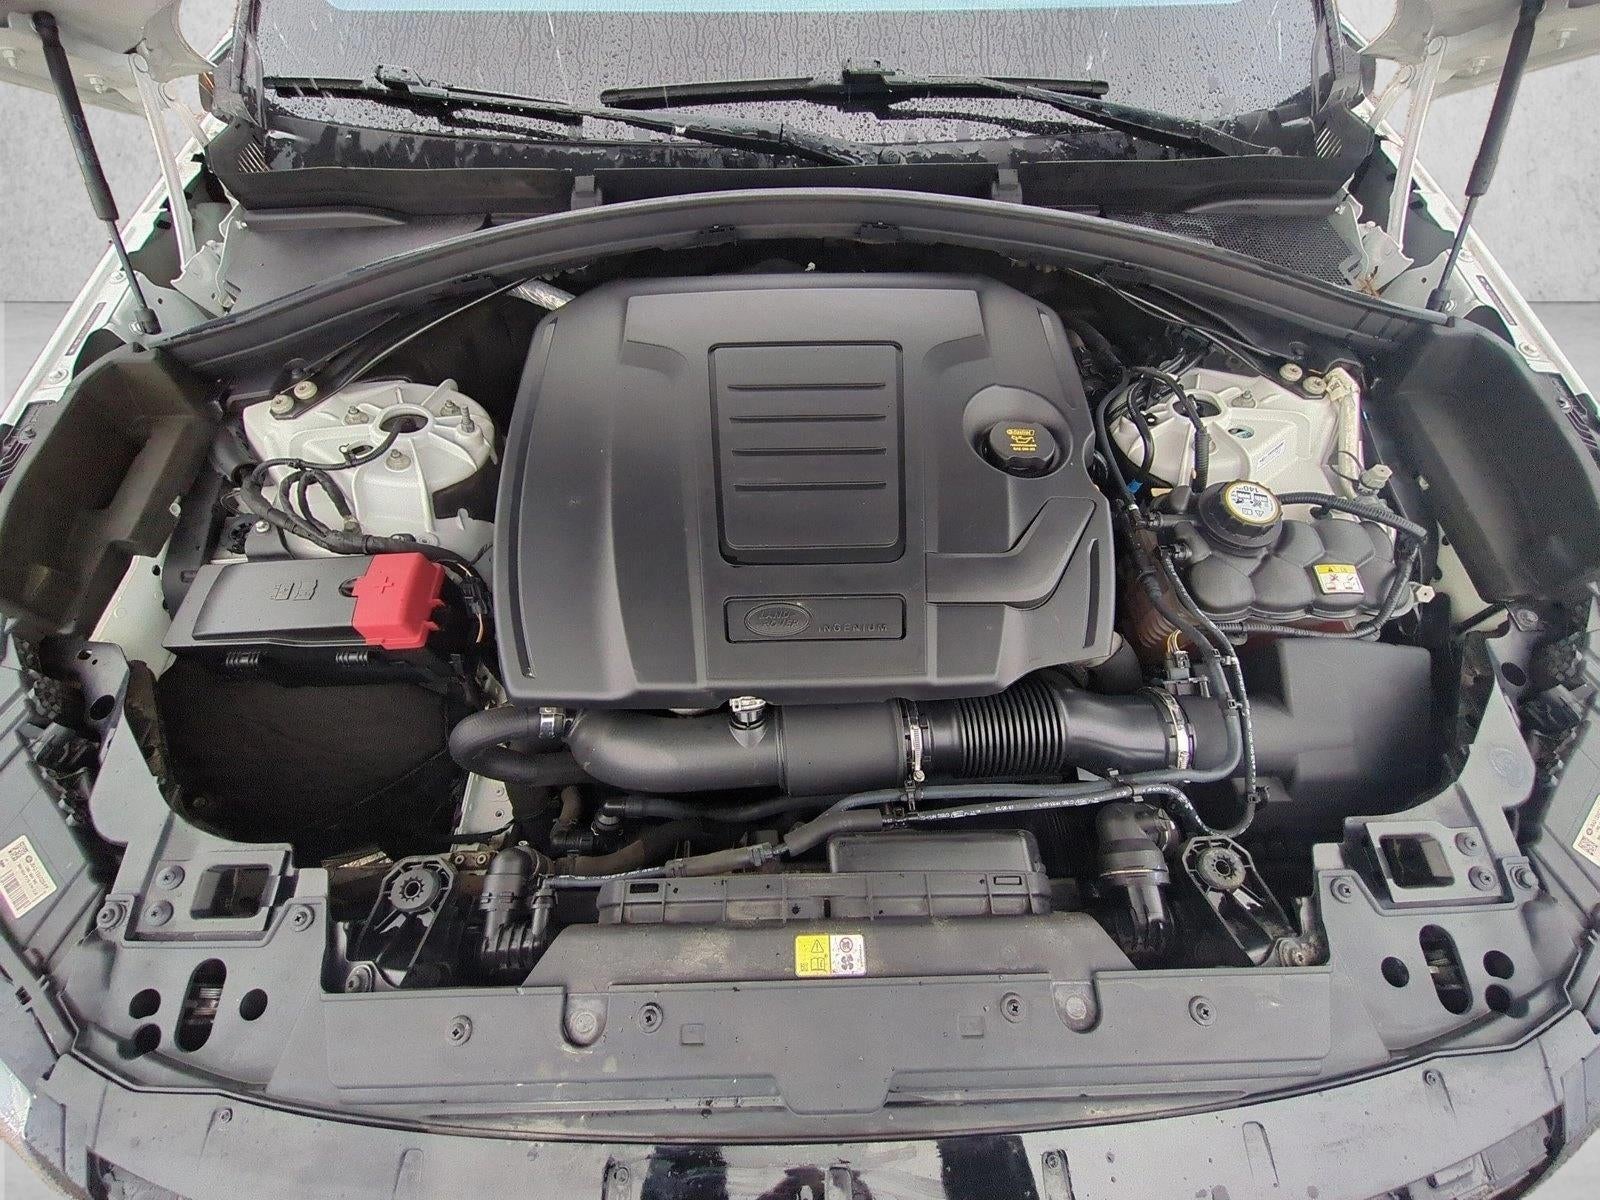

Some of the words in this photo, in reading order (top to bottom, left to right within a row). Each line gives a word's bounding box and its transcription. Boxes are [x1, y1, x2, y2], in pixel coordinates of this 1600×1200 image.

[760, 607, 791, 618] LAND
[761, 618, 800, 628] ROVER
[818, 623, 888, 633] INGENIUM
